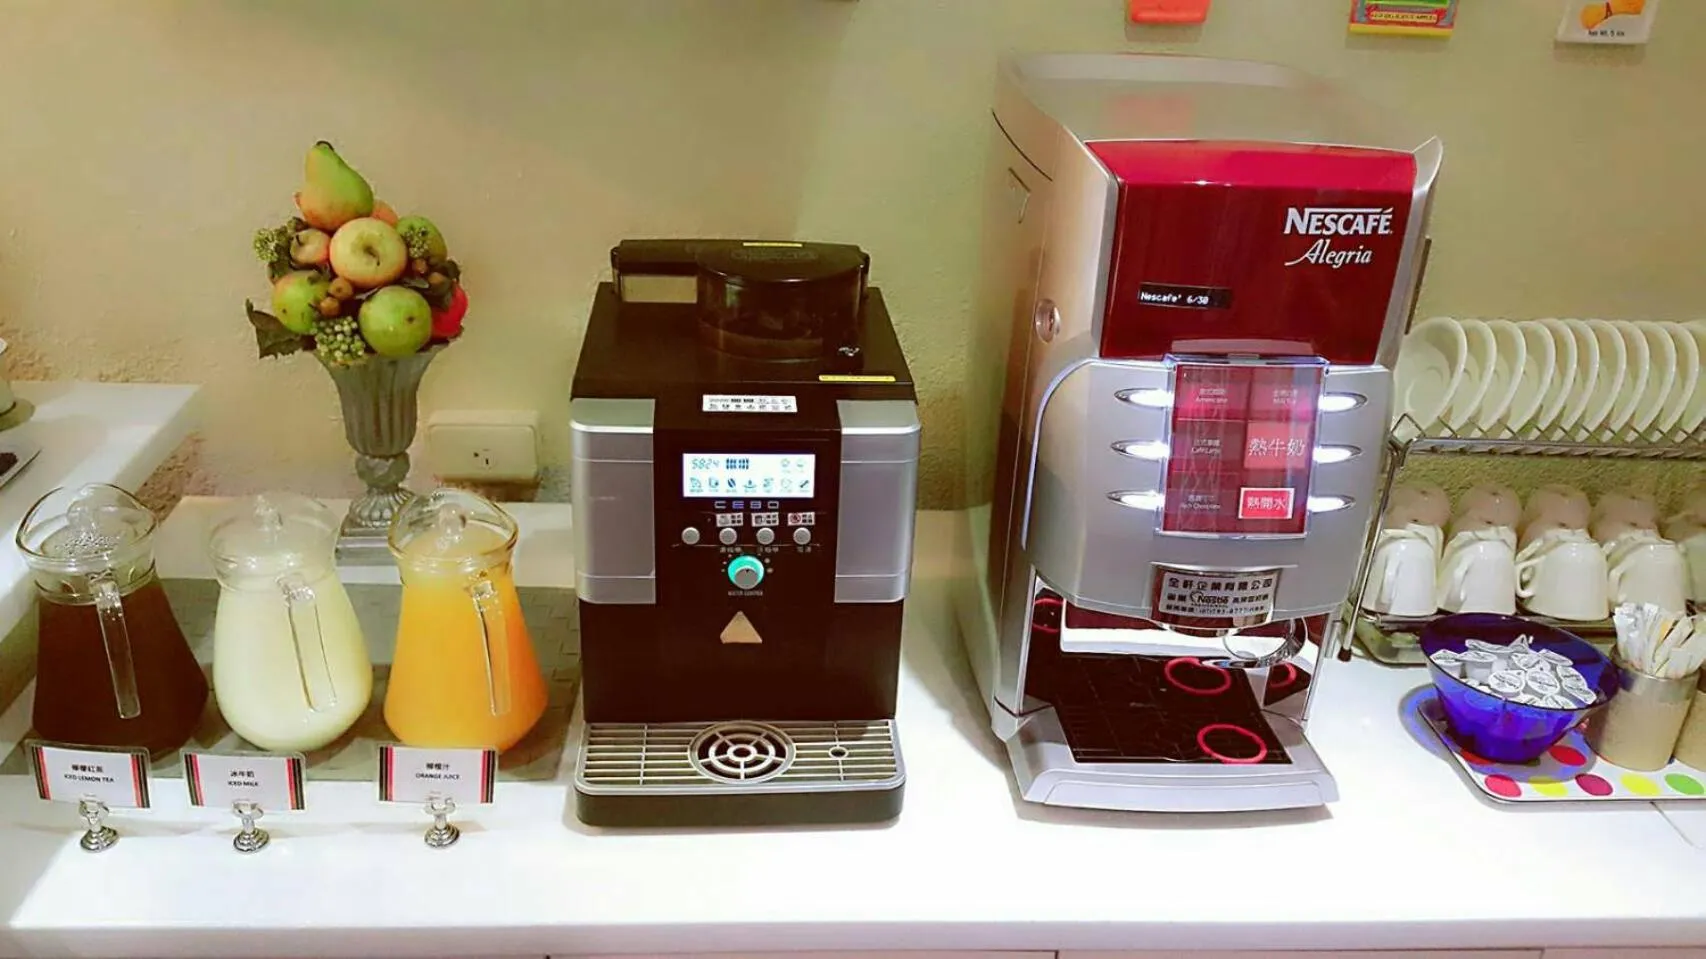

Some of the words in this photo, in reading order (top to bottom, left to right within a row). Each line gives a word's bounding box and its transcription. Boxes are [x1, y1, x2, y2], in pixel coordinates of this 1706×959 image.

[1283, 207, 1393, 235] NESCAFÉ
[1284, 238, 1373, 268] Alegria
[1248, 437, 1305, 456] 熱牛奶
